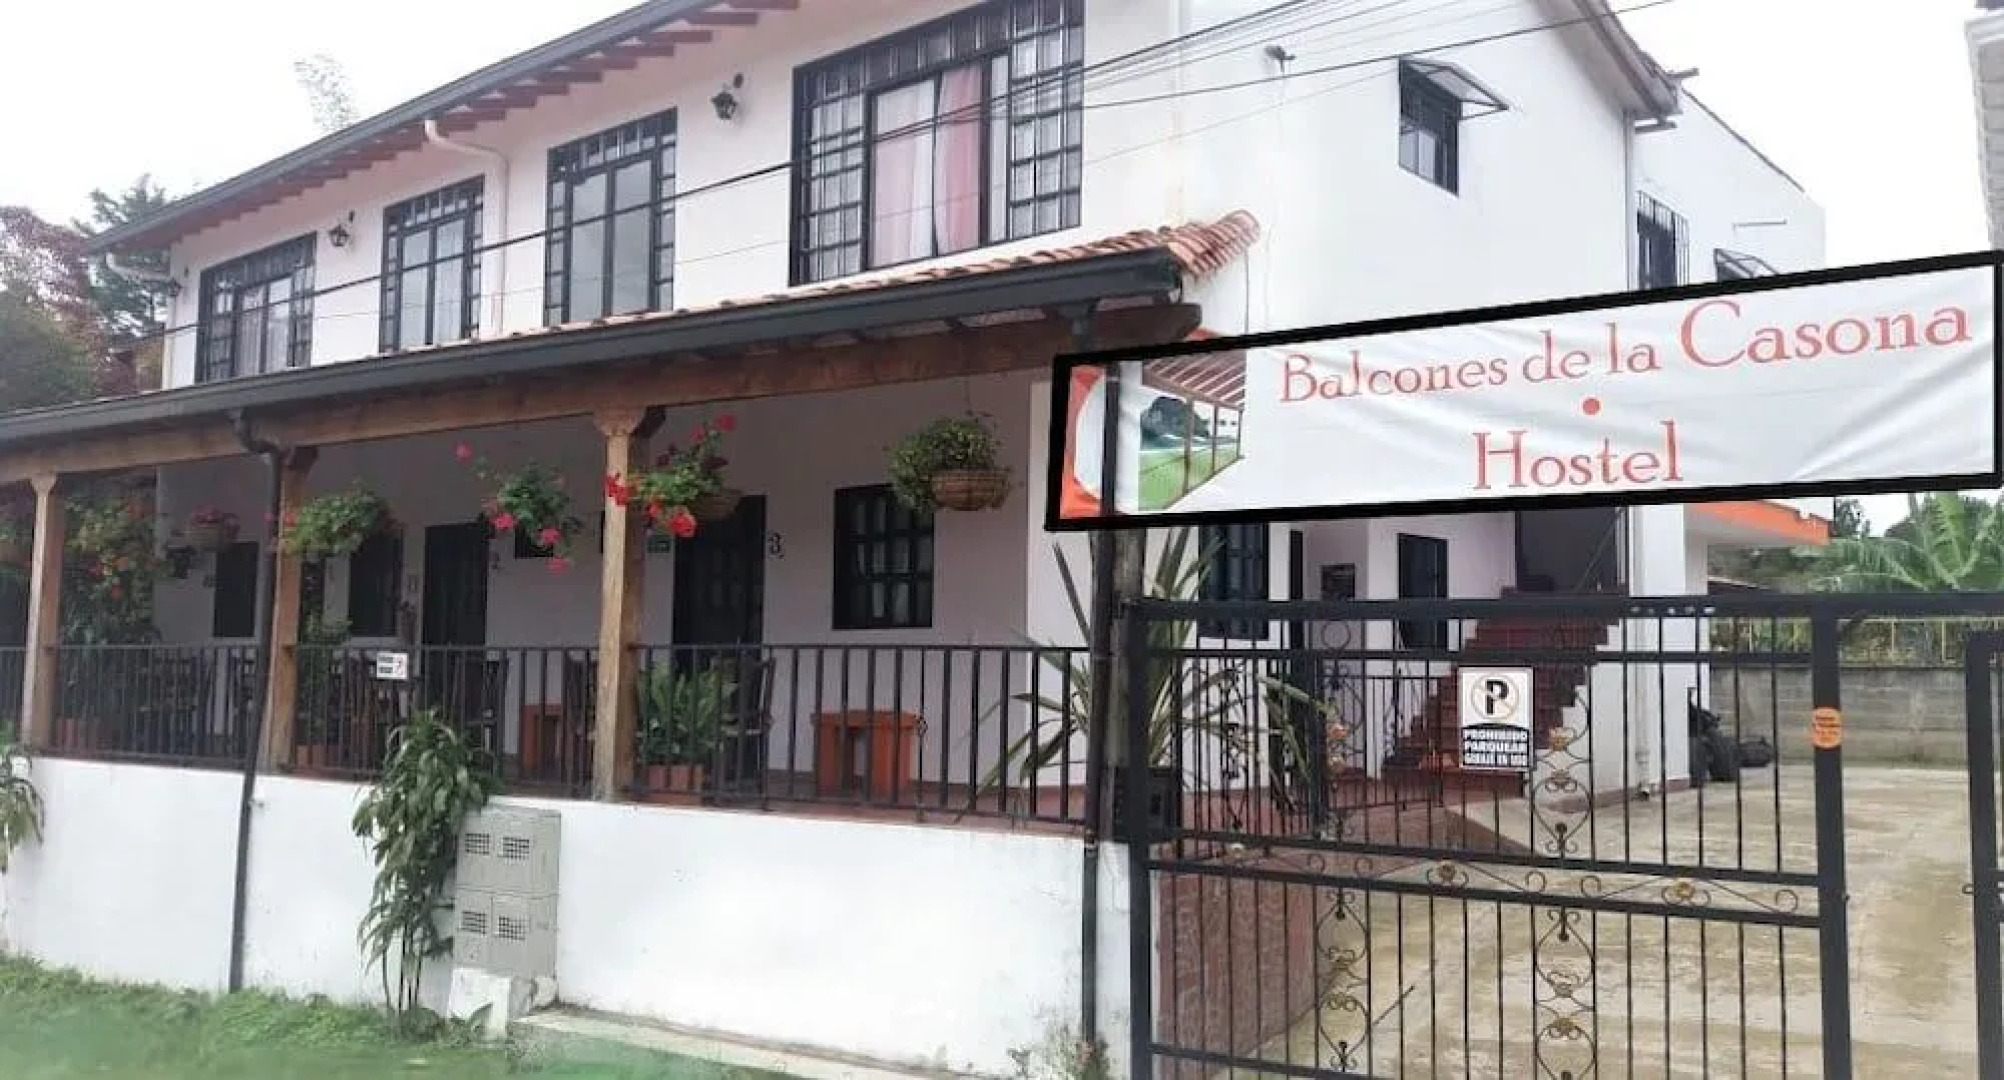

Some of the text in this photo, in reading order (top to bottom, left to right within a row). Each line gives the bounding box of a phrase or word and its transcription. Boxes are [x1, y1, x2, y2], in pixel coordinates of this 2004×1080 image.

[1279, 299, 1972, 402] Balcones de la Casona
[1472, 417, 1683, 490] Hostel
